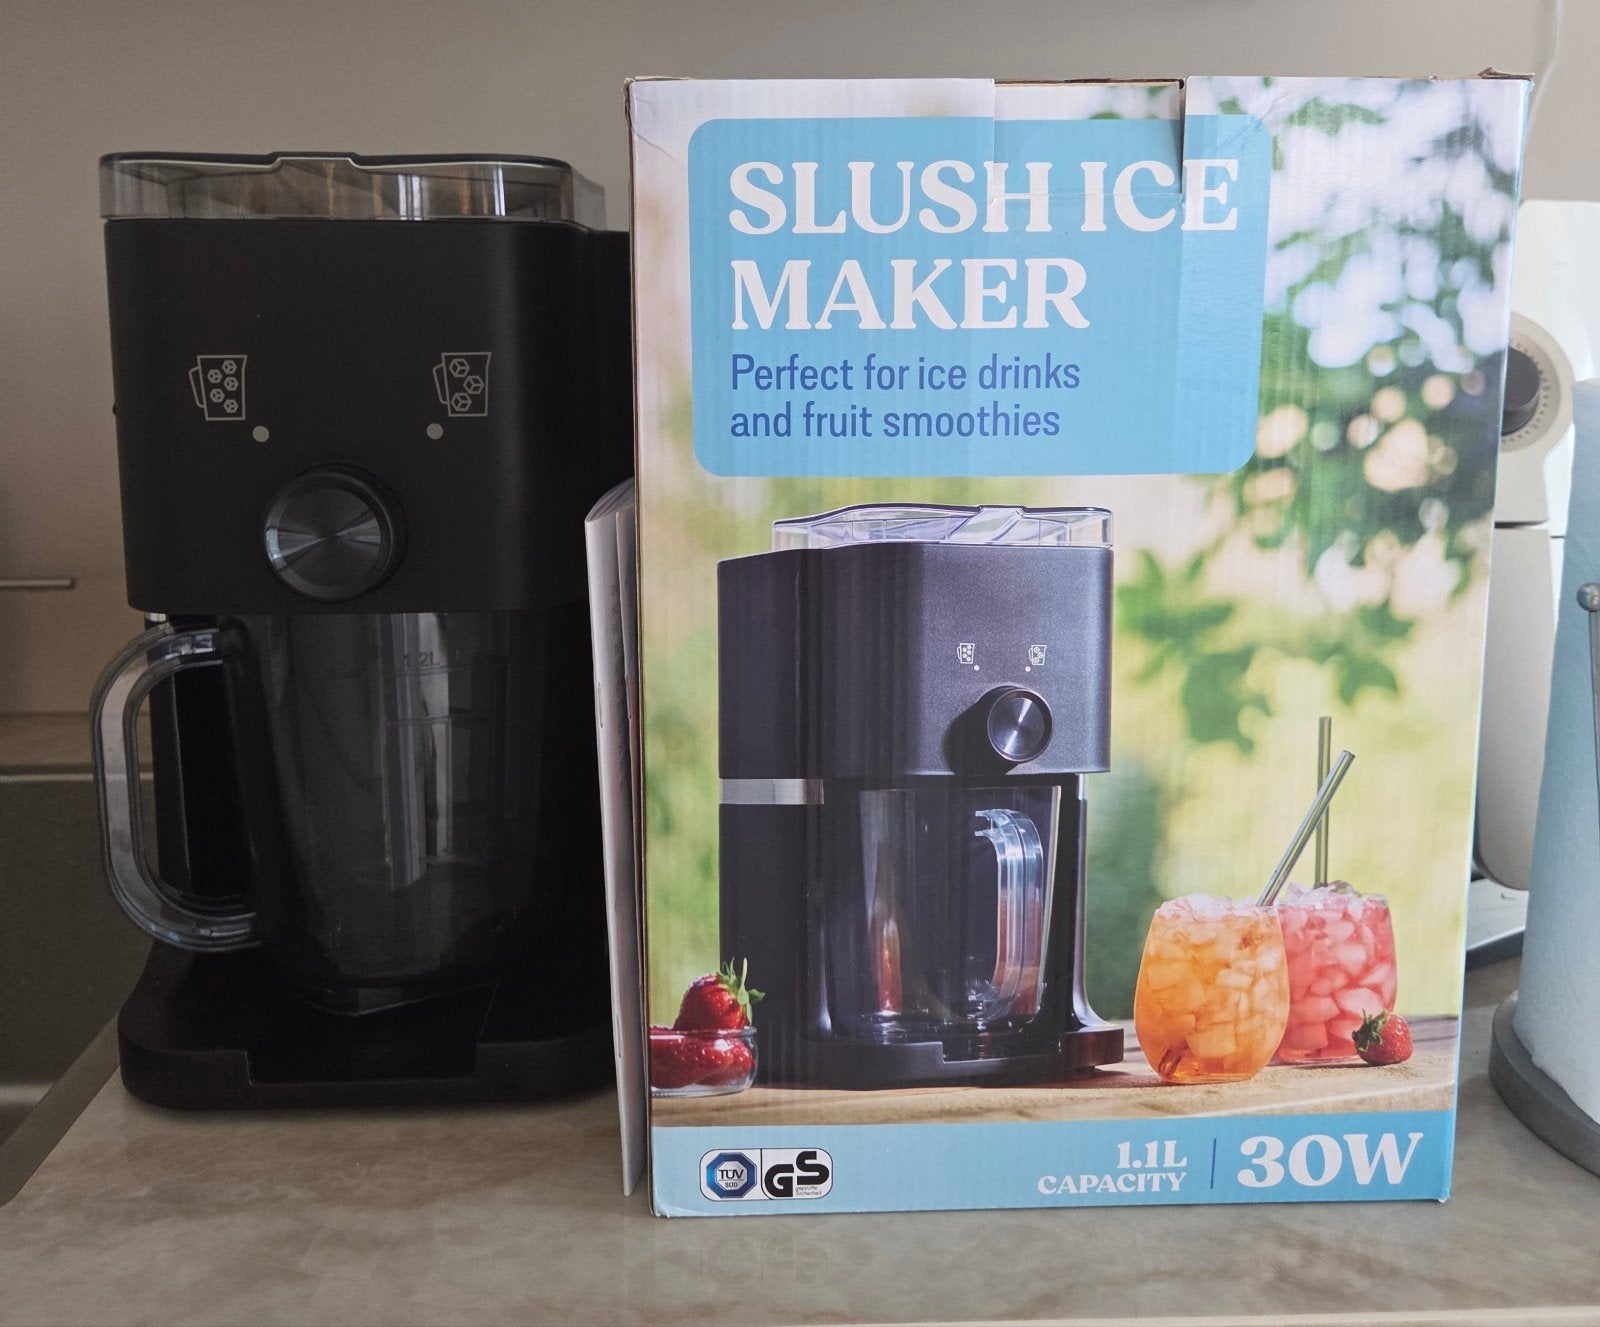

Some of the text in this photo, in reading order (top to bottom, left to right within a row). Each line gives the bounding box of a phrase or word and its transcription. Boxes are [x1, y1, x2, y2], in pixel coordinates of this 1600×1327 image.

[729, 158, 1239, 234] SLUSH ICE
[730, 258, 1091, 330] MAKER
[732, 353, 1081, 390] Perfect for ice drinks
[730, 401, 1060, 437] and fruit smoothies
[1117, 1140, 1188, 1169] 1.1L
[1237, 1133, 1424, 1188] 30W
[718, 1168, 744, 1180] TÜV
[764, 1151, 830, 1197] GS
[1037, 1172, 1187, 1195] CAPACITY
